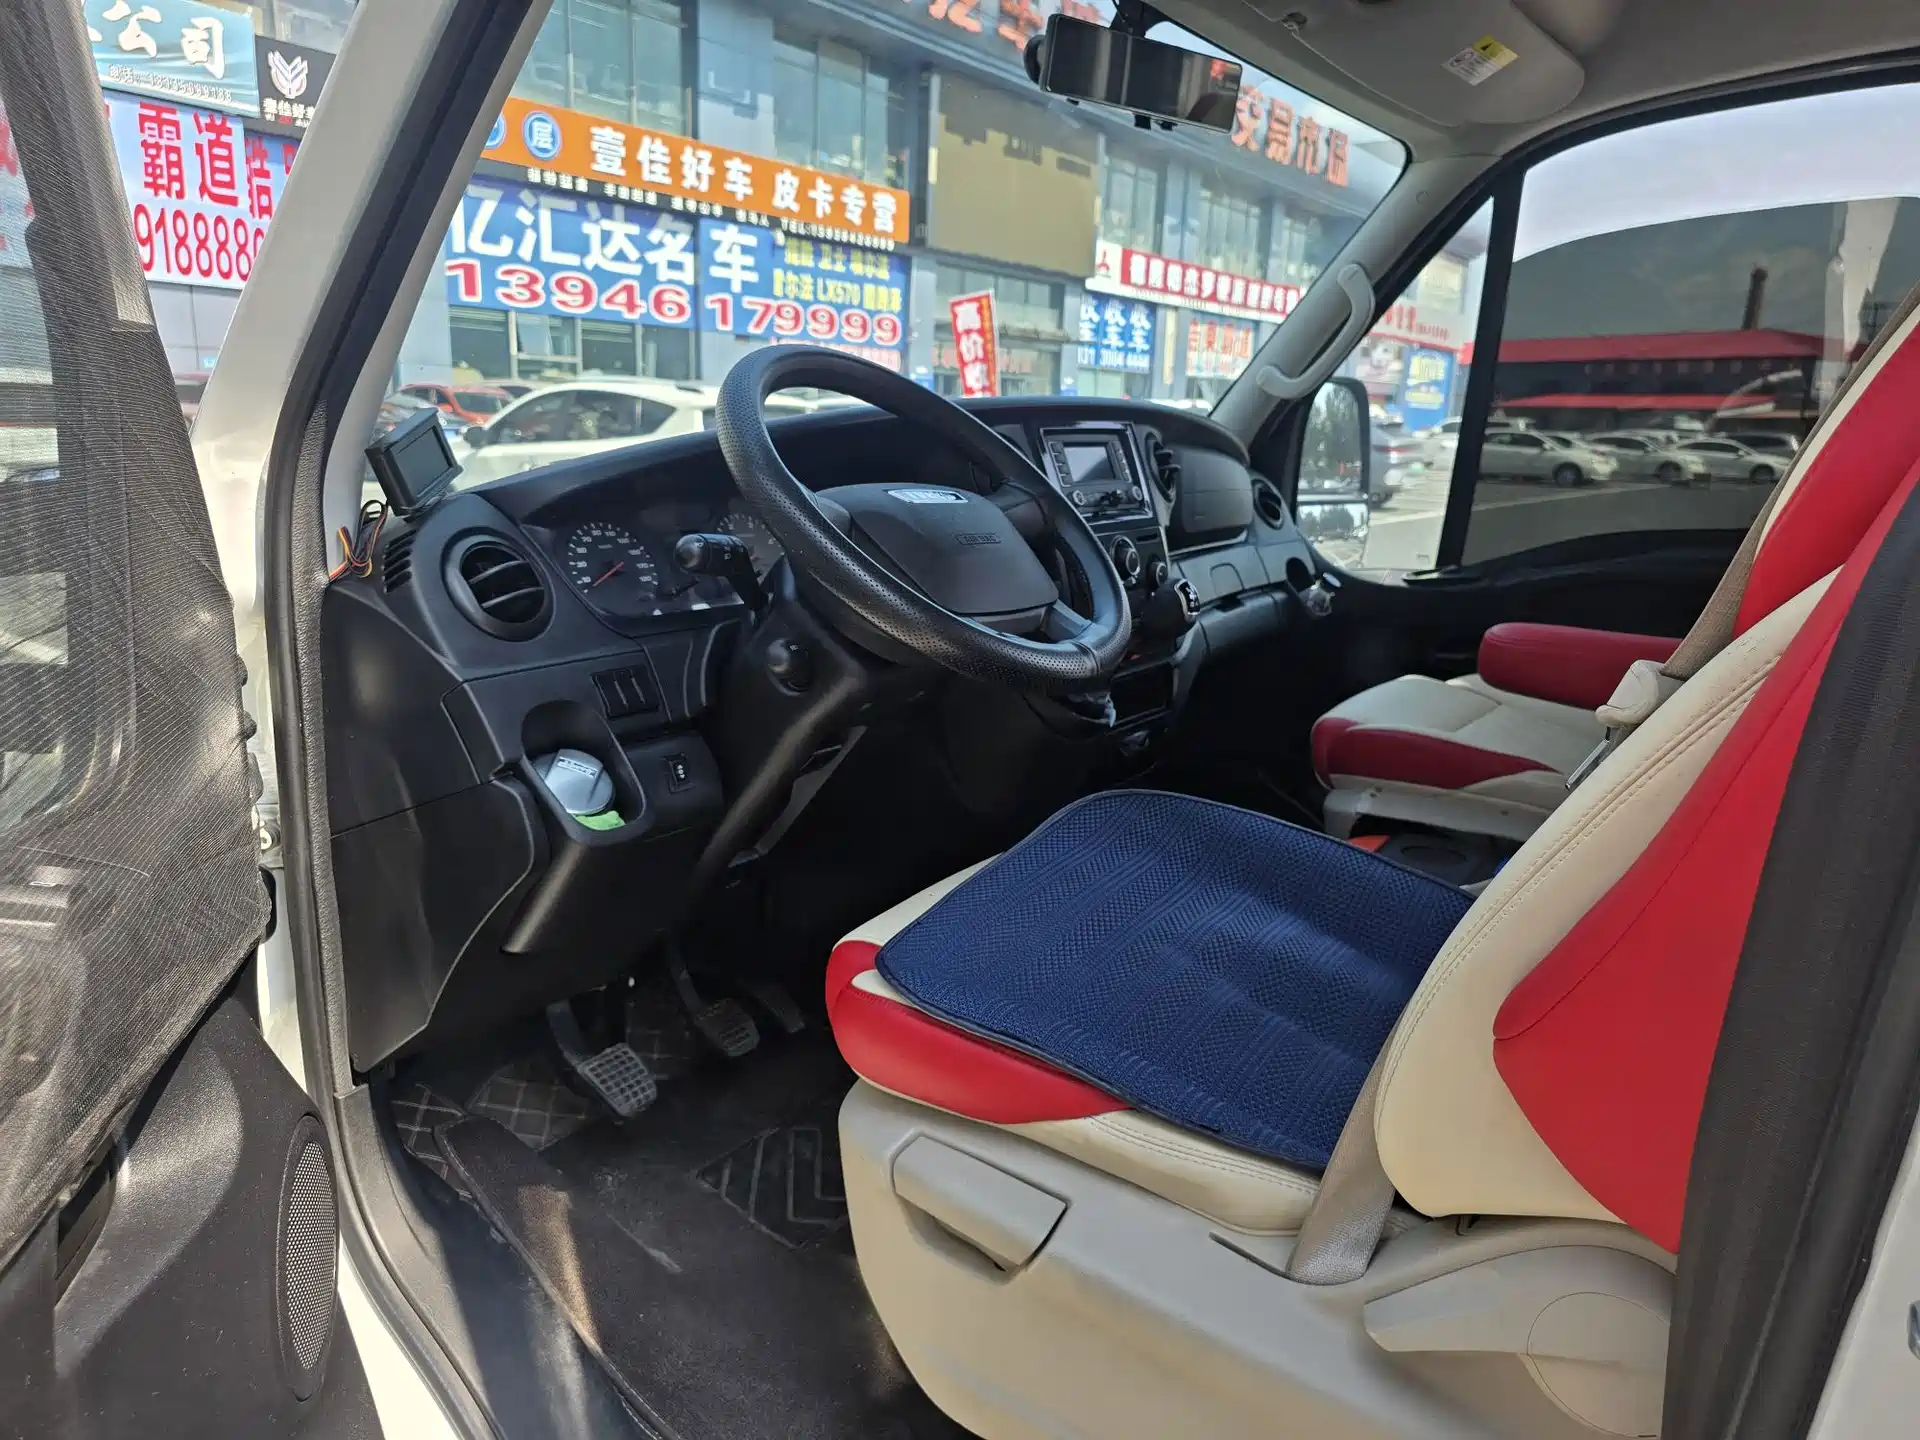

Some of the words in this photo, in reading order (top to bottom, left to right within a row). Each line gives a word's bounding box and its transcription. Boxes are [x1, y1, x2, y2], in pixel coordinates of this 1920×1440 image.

[589, 125, 754, 202] 壹佳好车
[771, 168, 897, 233] 皮卡专营
[451, 183, 760, 294] 亿汇达名车
